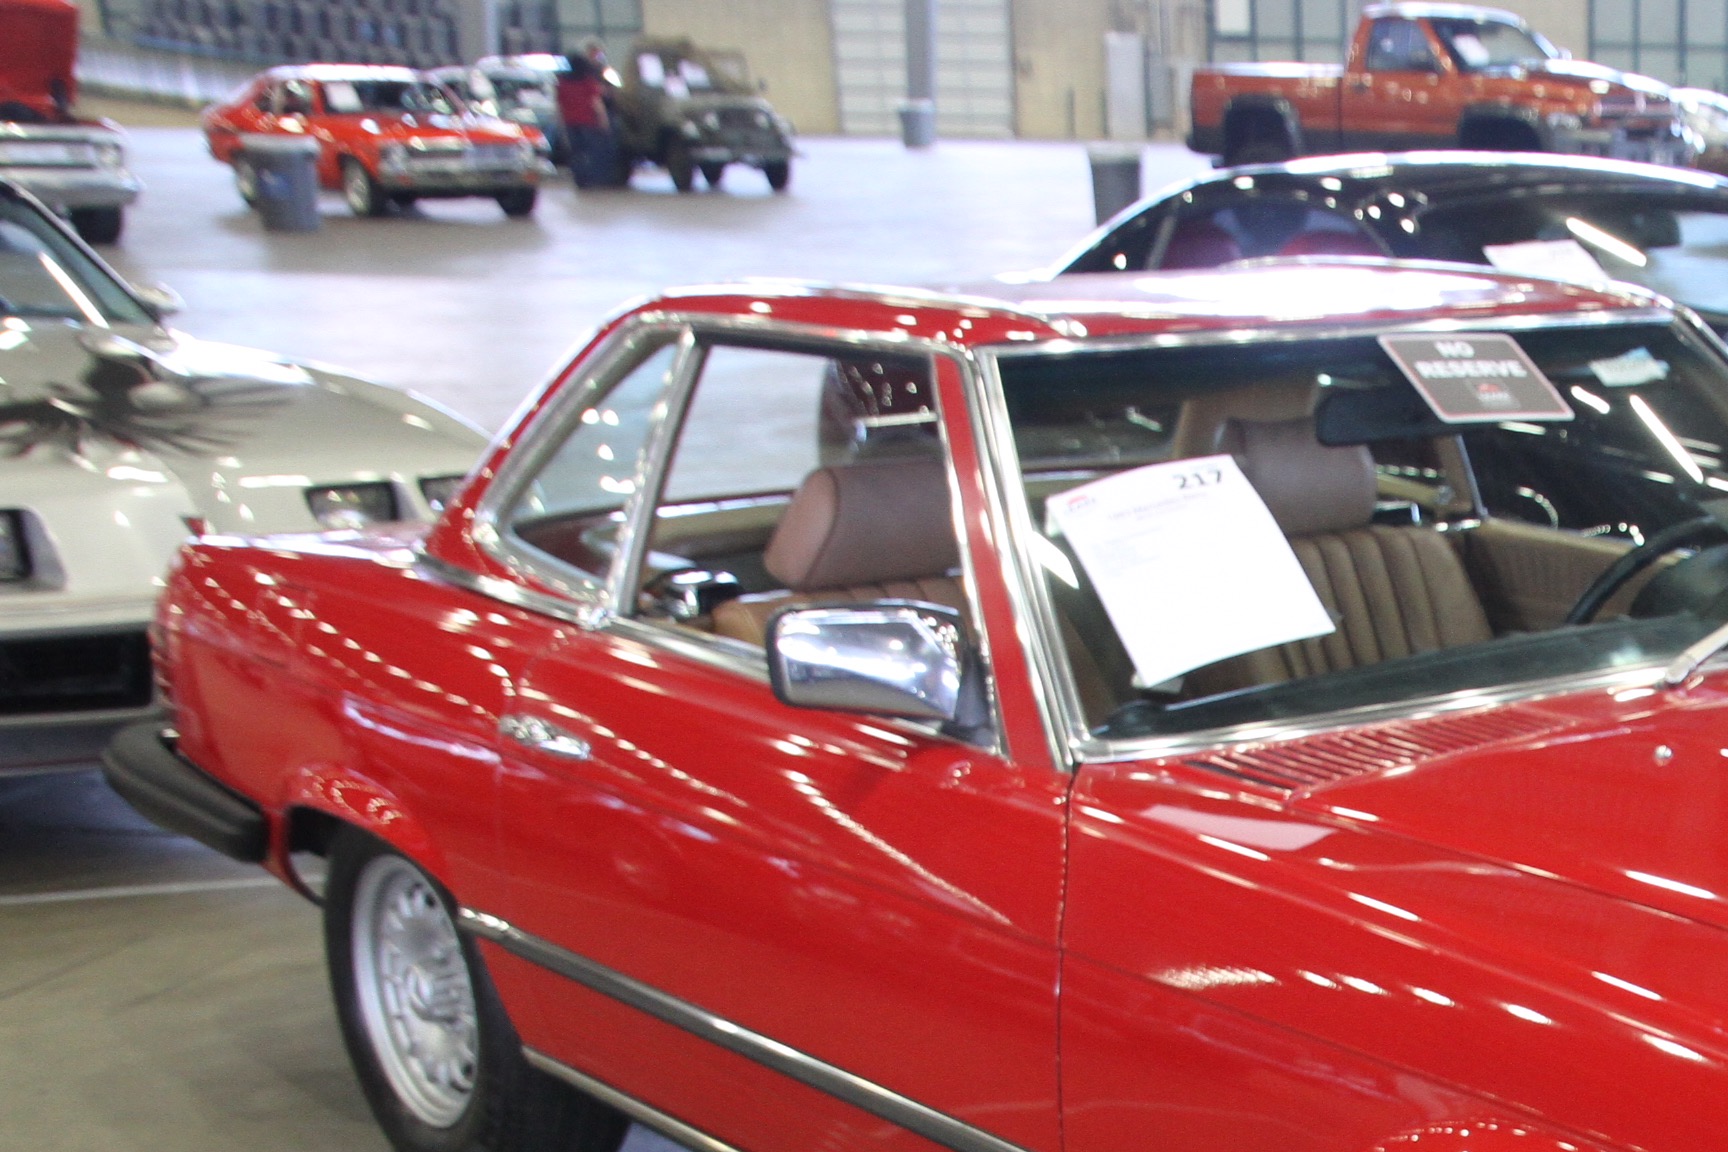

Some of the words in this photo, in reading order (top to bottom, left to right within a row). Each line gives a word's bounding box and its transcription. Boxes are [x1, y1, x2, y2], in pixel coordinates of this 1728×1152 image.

[1434, 341, 1475, 358] NO
[1413, 360, 1528, 378] RESERVE
[1171, 469, 1223, 490] 217
